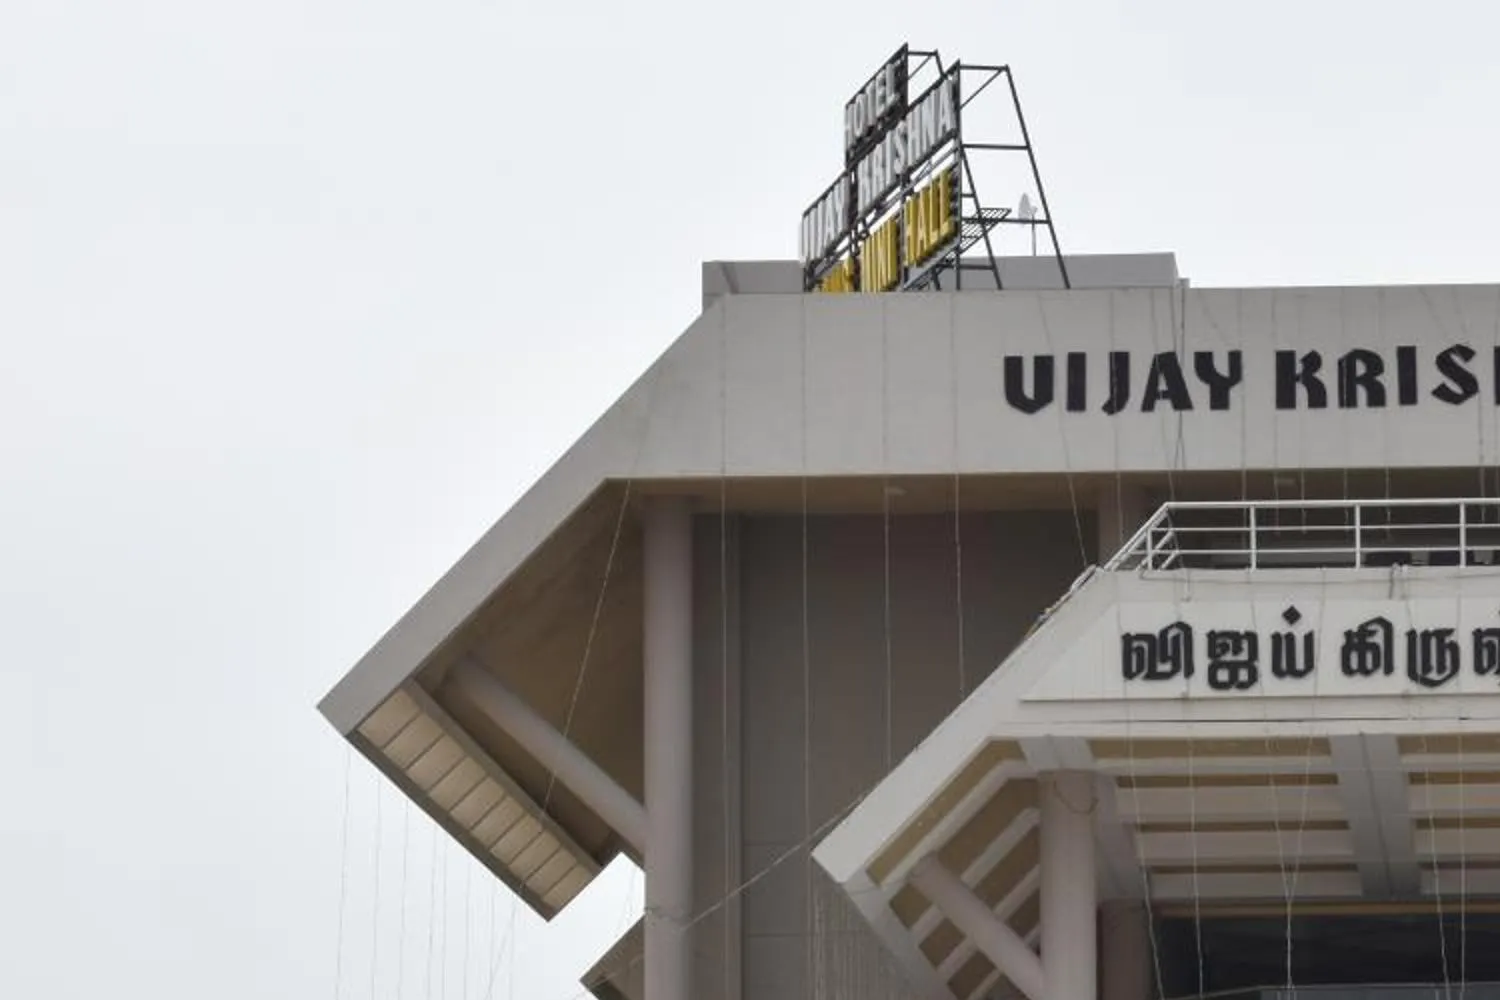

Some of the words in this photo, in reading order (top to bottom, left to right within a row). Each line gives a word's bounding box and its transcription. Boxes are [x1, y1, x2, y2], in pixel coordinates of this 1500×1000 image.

[845, 62, 900, 147] HOTEL
[857, 76, 956, 217] KRISHNA
[904, 169, 955, 266] HALL
